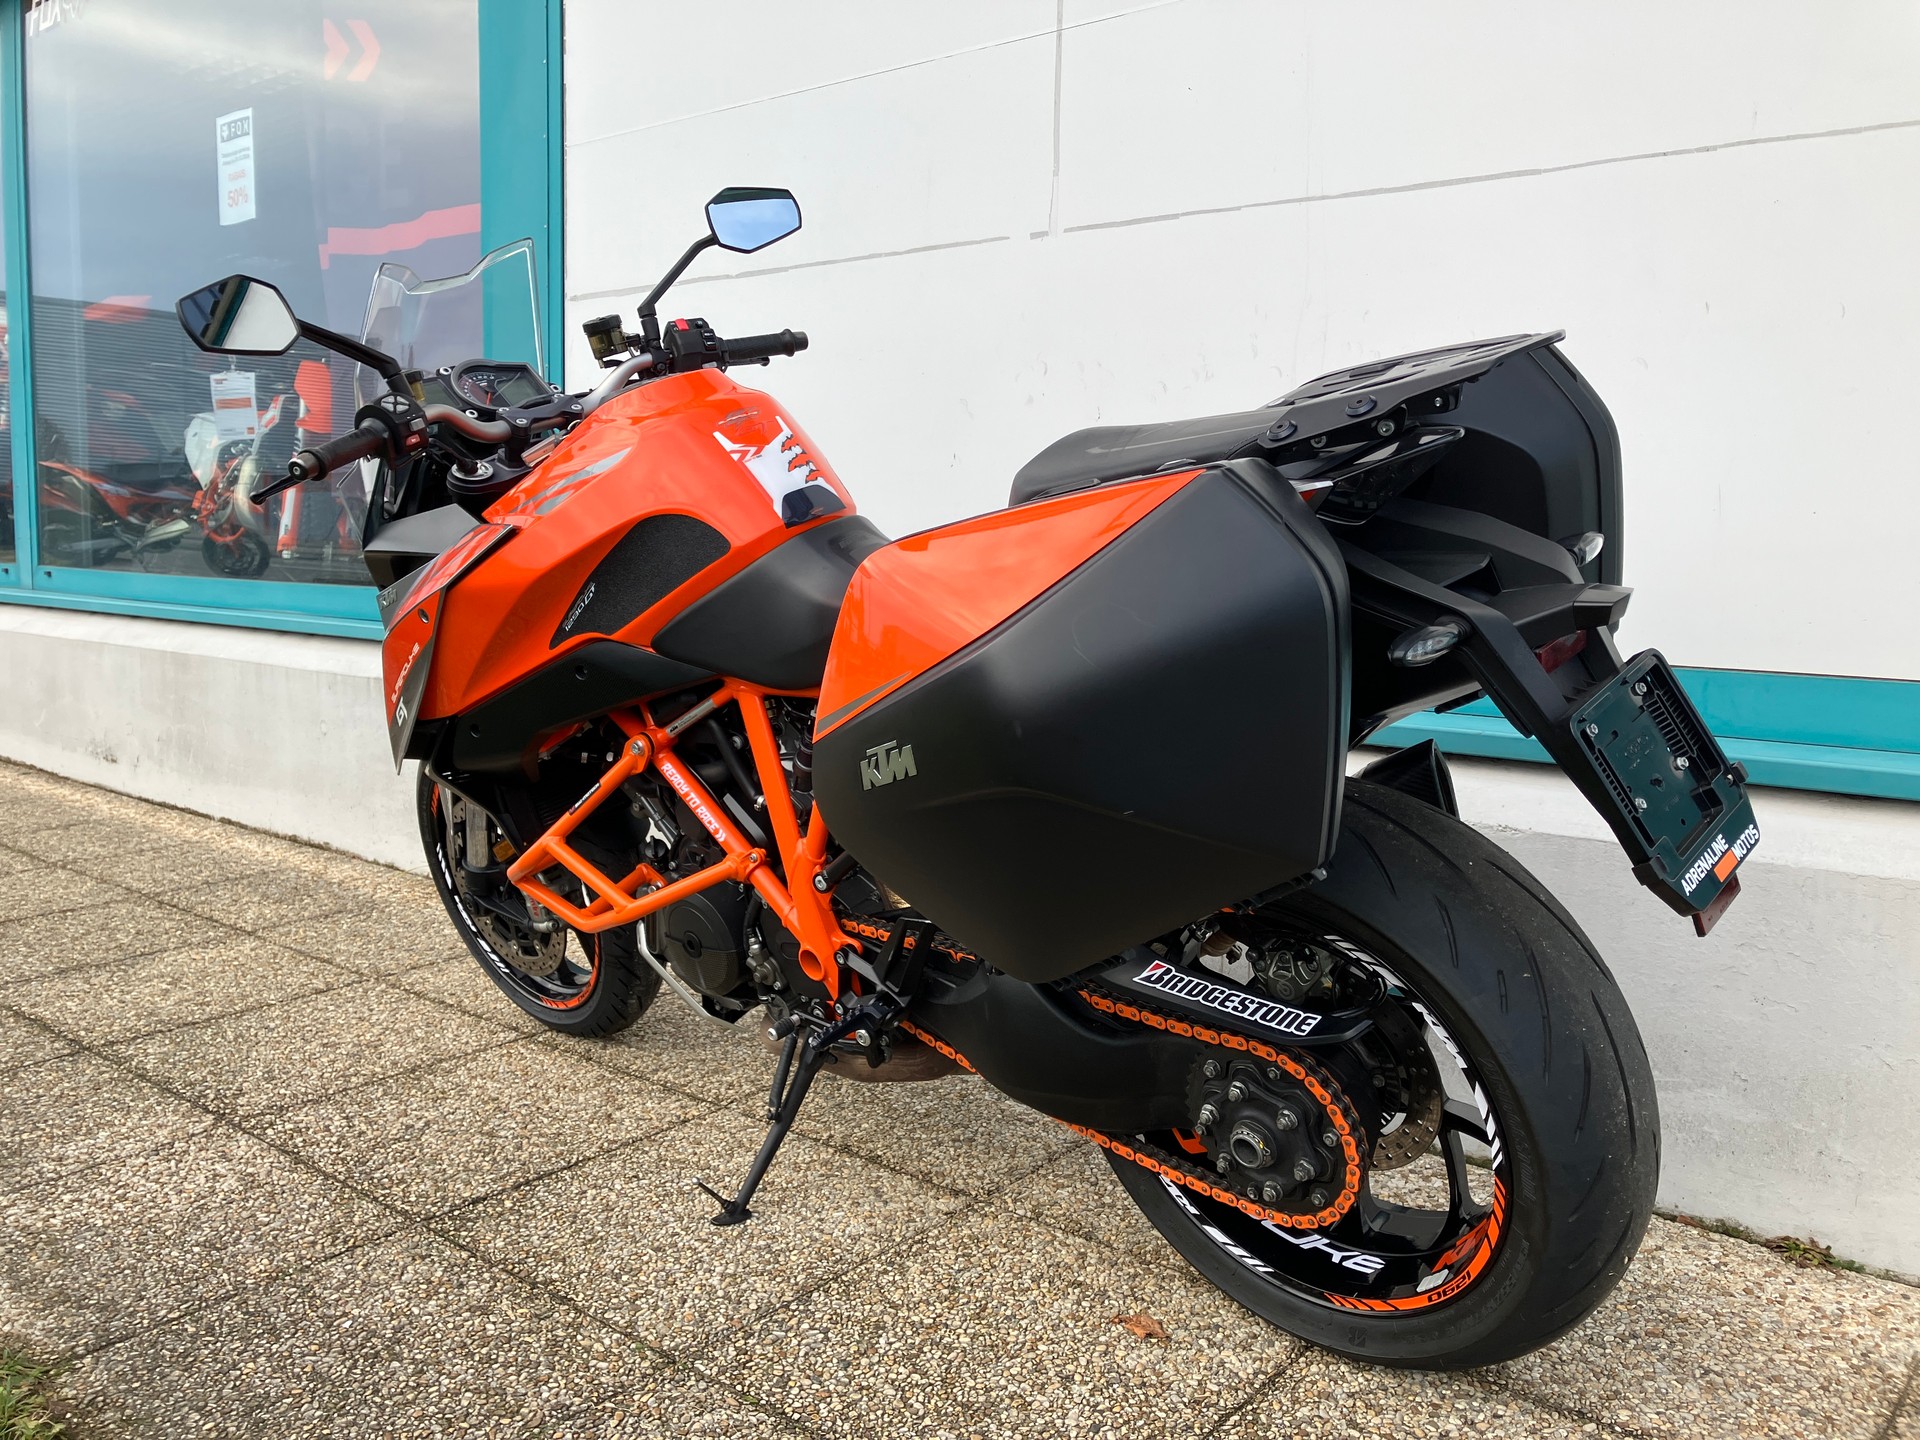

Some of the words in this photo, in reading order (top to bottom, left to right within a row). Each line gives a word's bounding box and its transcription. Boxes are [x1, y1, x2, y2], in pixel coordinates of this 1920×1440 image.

[230, 119, 249, 137] FOX
[227, 185, 249, 208] 50%
[396, 697, 408, 727] GT
[860, 739, 918, 791] KTM
[661, 763, 690, 795] READY
[686, 792, 701, 808] TO
[695, 806, 720, 833] RACE
[1731, 824, 1760, 861] MOTOS
[1681, 833, 1729, 896] ADRENALINE
[1133, 960, 1322, 1036] BRIDGESTONE
[1427, 1270, 1472, 1304] 1290
